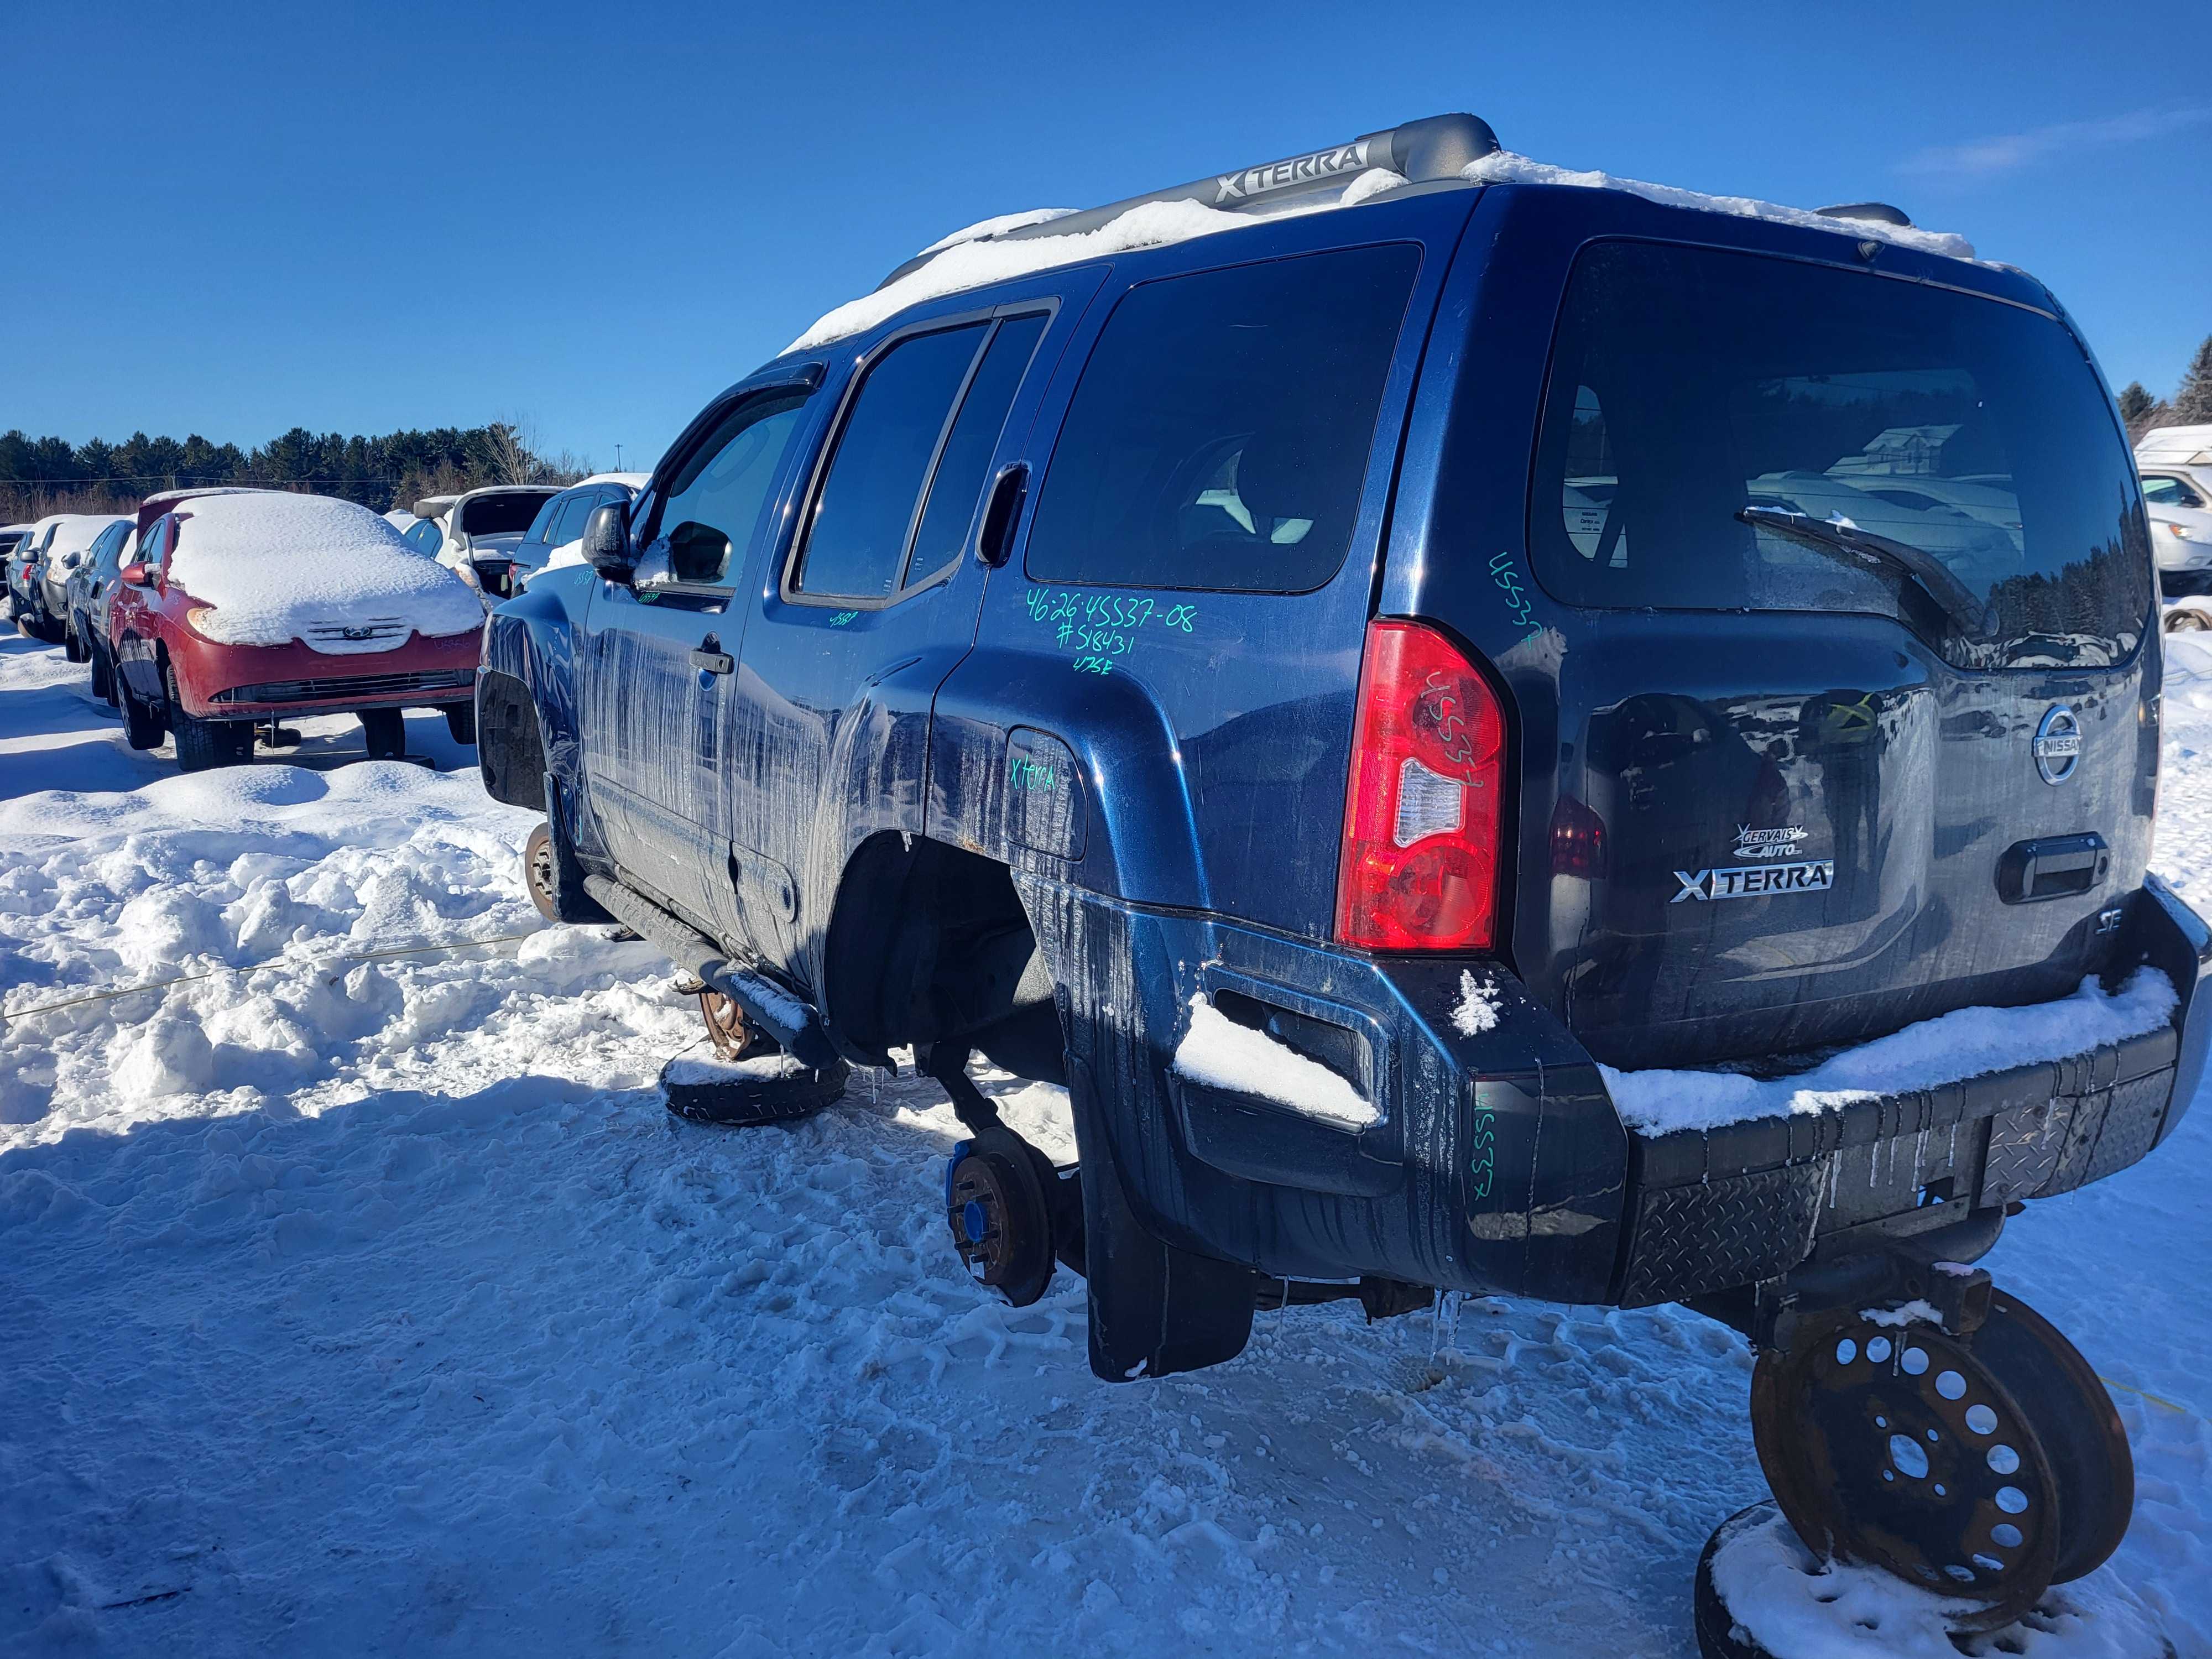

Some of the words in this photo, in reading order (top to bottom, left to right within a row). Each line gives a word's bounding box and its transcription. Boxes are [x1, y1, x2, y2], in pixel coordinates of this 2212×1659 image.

[1214, 145, 1364, 204] XTERRA
[1743, 828, 1795, 843] GERVAIS
[1760, 844, 1796, 858] AUTO
[1669, 860, 1834, 902] XTERRA
[2096, 909, 2122, 935] SE
